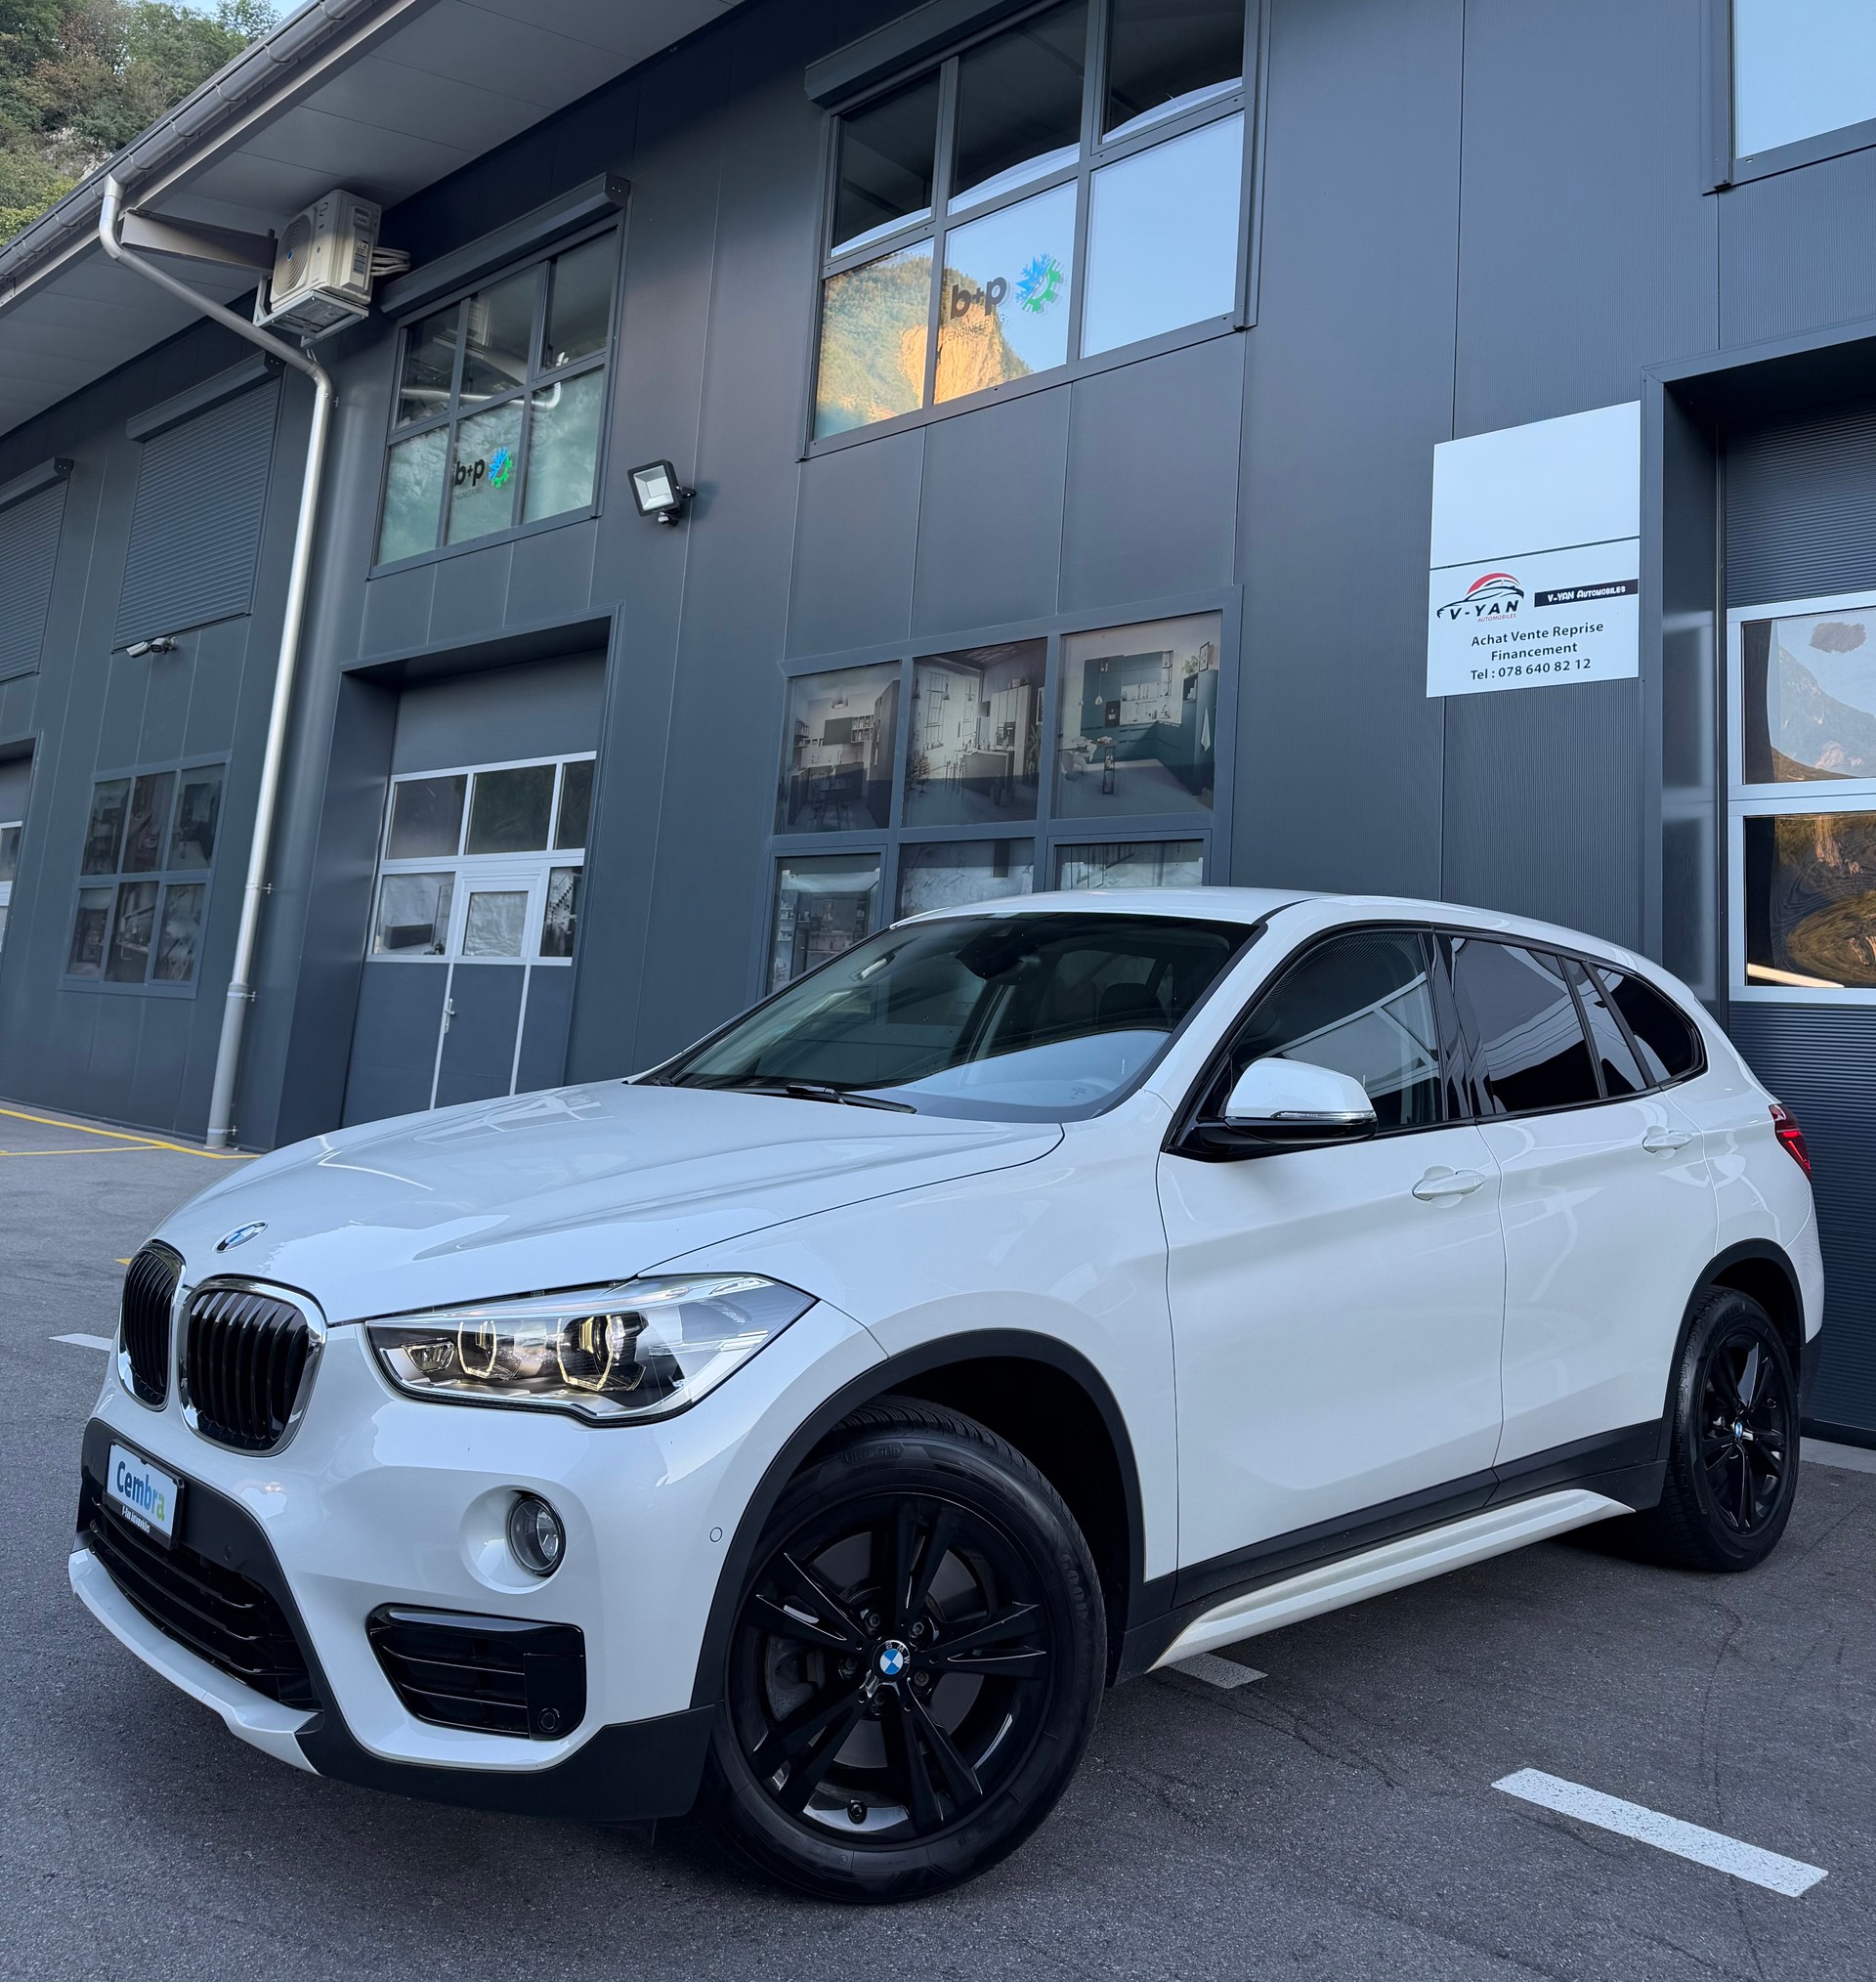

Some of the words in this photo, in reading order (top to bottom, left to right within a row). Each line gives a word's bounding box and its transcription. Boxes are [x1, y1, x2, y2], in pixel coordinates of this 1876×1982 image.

[948, 313, 1005, 341] ENGINEERING
[1547, 590, 1574, 602] V-YAN
[1449, 599, 1519, 621] V-YAN
[1477, 613, 1516, 623] AUTOMOBILES
[1471, 632, 1508, 647] Achat
[1511, 628, 1549, 642] Vente
[1553, 622, 1604, 639] Reprise
[1491, 642, 1578, 662] Financement
[1498, 666, 1522, 678] 078
[1525, 663, 1551, 675] 640
[1554, 660, 1570, 672] 82
[1575, 658, 1591, 669] 12
[116, 1460, 166, 1522] Cembra
[884, 1641, 911, 1664] BMW
